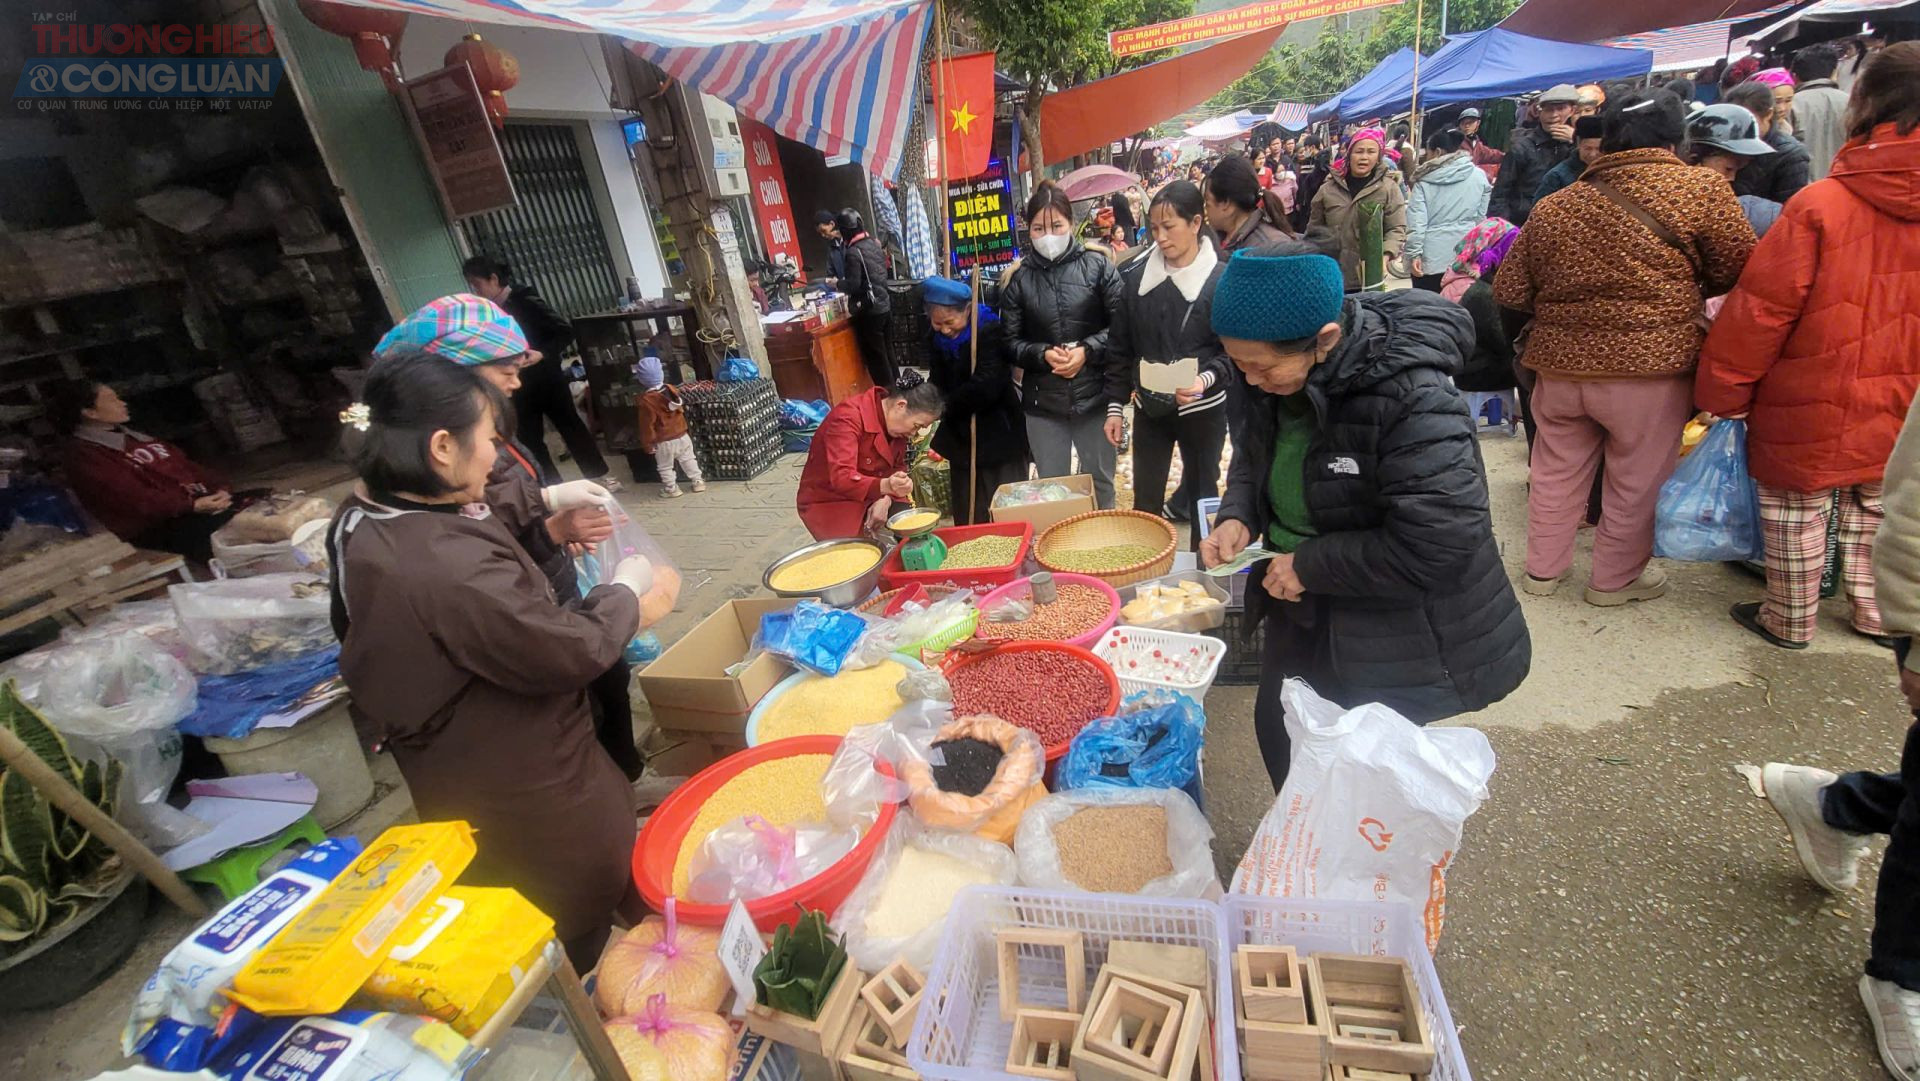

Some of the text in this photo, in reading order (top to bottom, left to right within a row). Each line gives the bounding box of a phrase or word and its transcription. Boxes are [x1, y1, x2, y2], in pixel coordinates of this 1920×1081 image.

[1117, 44, 1128, 55] LÀ
[1129, 38, 1152, 52] NHÂN
[1154, 36, 1164, 46] TỐ
[1166, 32, 1192, 45] QUYẾT
[1216, 21, 1244, 34] THÀNH
[1264, 13, 1282, 25] CỦA
[1284, 11, 1296, 22] SỰ
[1299, 4, 1332, 18] NGHIỆP
[1118, 32, 1134, 44] SỨC
[1136, 28, 1160, 42] MẠNH
[1162, 24, 1179, 34] CỦA
[1181, 20, 1206, 30] NHÂN
[1227, 10, 1238, 20] VÀ
[1240, 6, 1261, 19] KHỐI
[752, 132, 772, 166] SỬA
[760, 176, 784, 206] CHỮA
[976, 180, 989, 192] SỬA
[989, 179, 1004, 190] CHỮA
[954, 194, 1000, 217] ĐIỆN
[770, 215, 792, 248] ĐIỆN
[953, 214, 1009, 239] THOẠI
